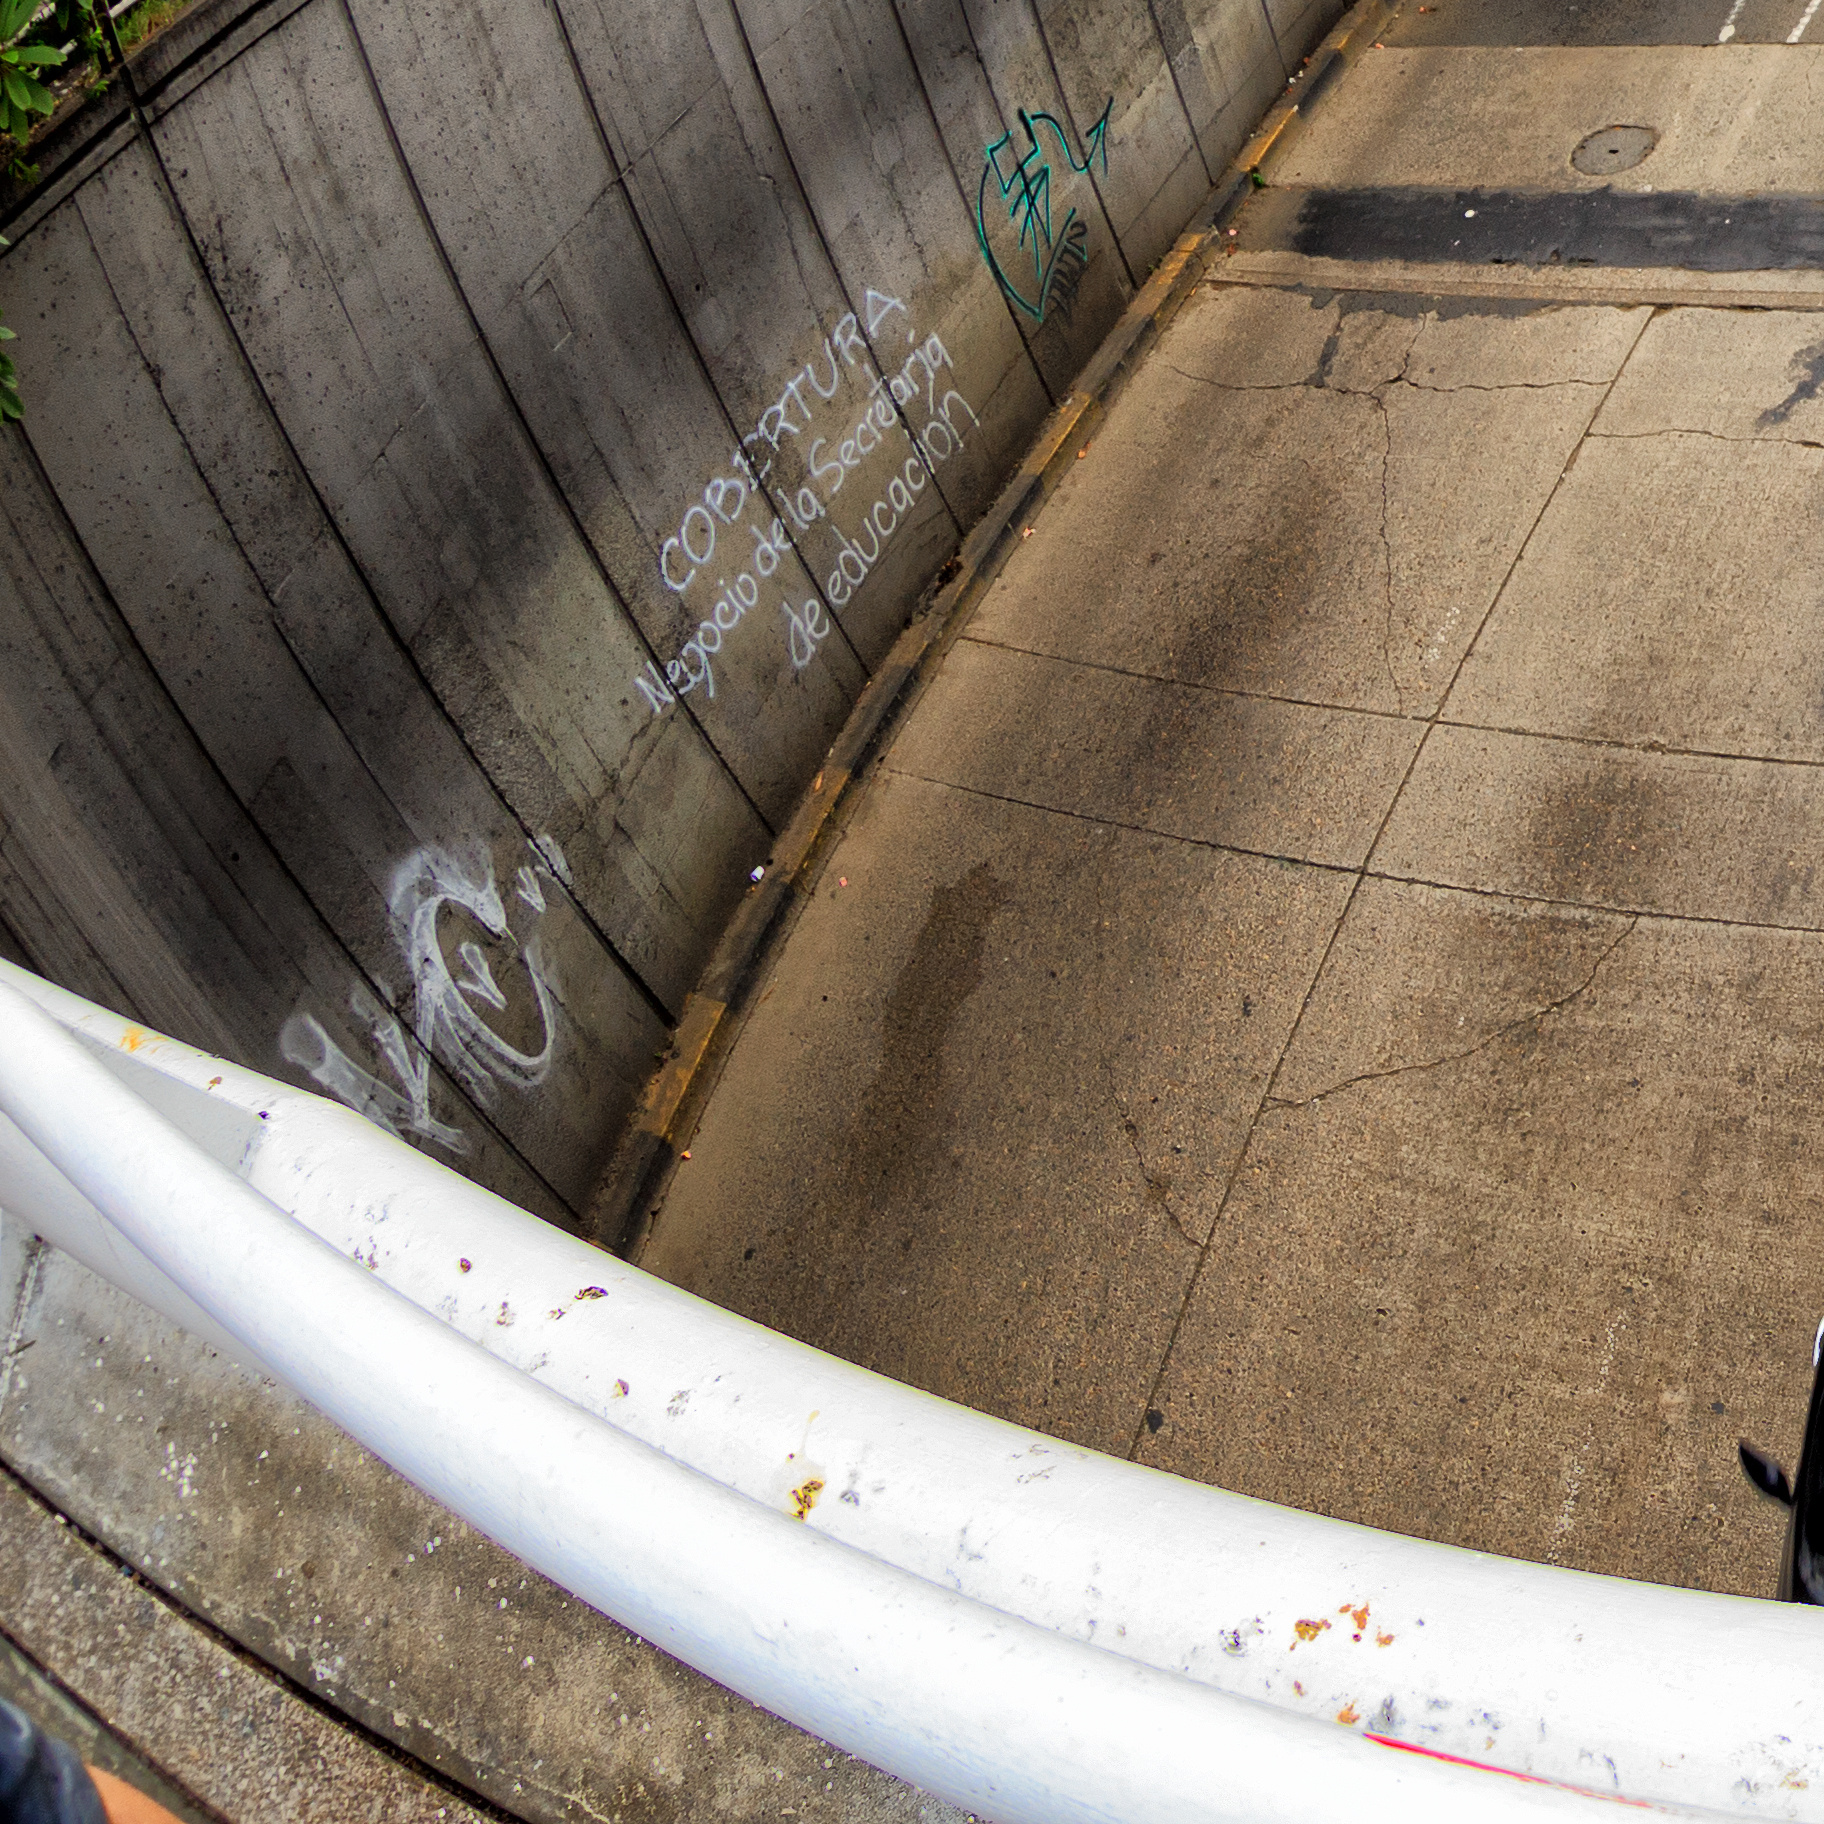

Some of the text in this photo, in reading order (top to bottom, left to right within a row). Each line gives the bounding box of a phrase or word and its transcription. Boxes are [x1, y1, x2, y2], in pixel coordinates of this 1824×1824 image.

[661, 288, 906, 592] COBERTURA
[750, 518, 793, 577] de
[777, 487, 826, 529] la
[782, 598, 830, 668] de
